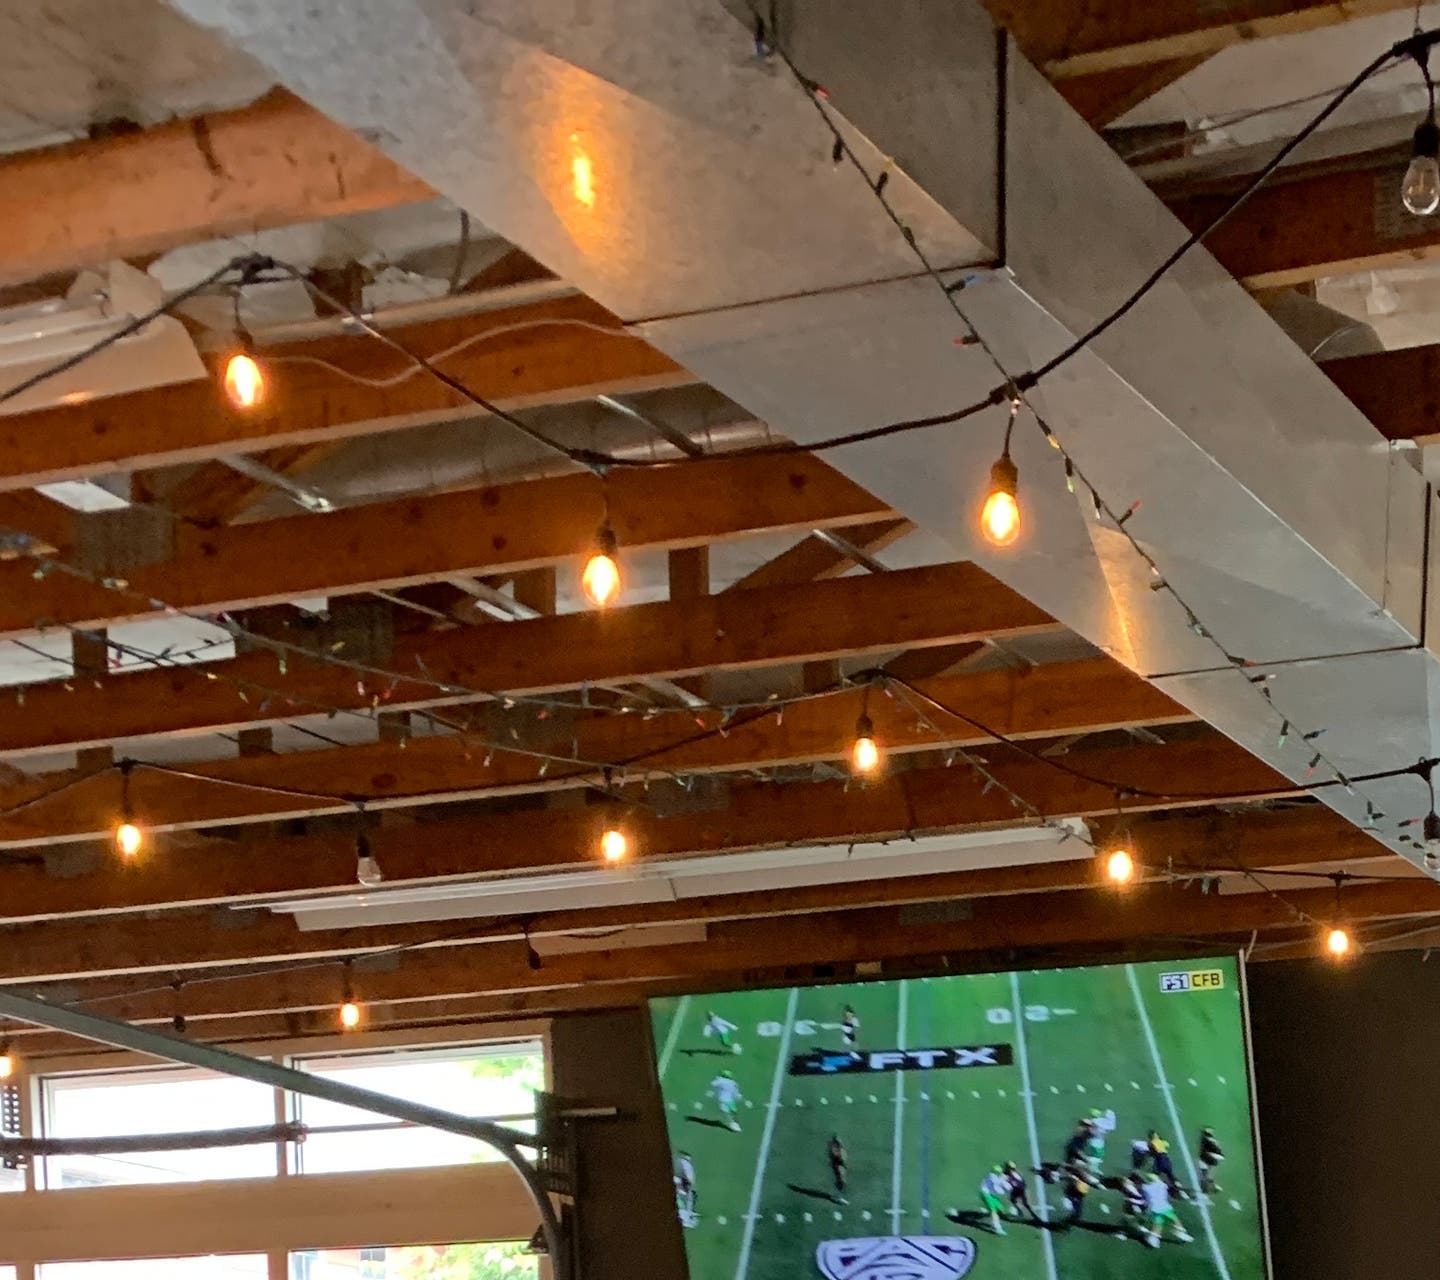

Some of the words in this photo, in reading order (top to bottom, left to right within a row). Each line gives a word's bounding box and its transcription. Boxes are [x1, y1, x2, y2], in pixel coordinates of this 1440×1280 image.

[1161, 974, 1189, 990] FS1
[1191, 973, 1221, 987] CFB
[869, 1046, 999, 1070] FTX
